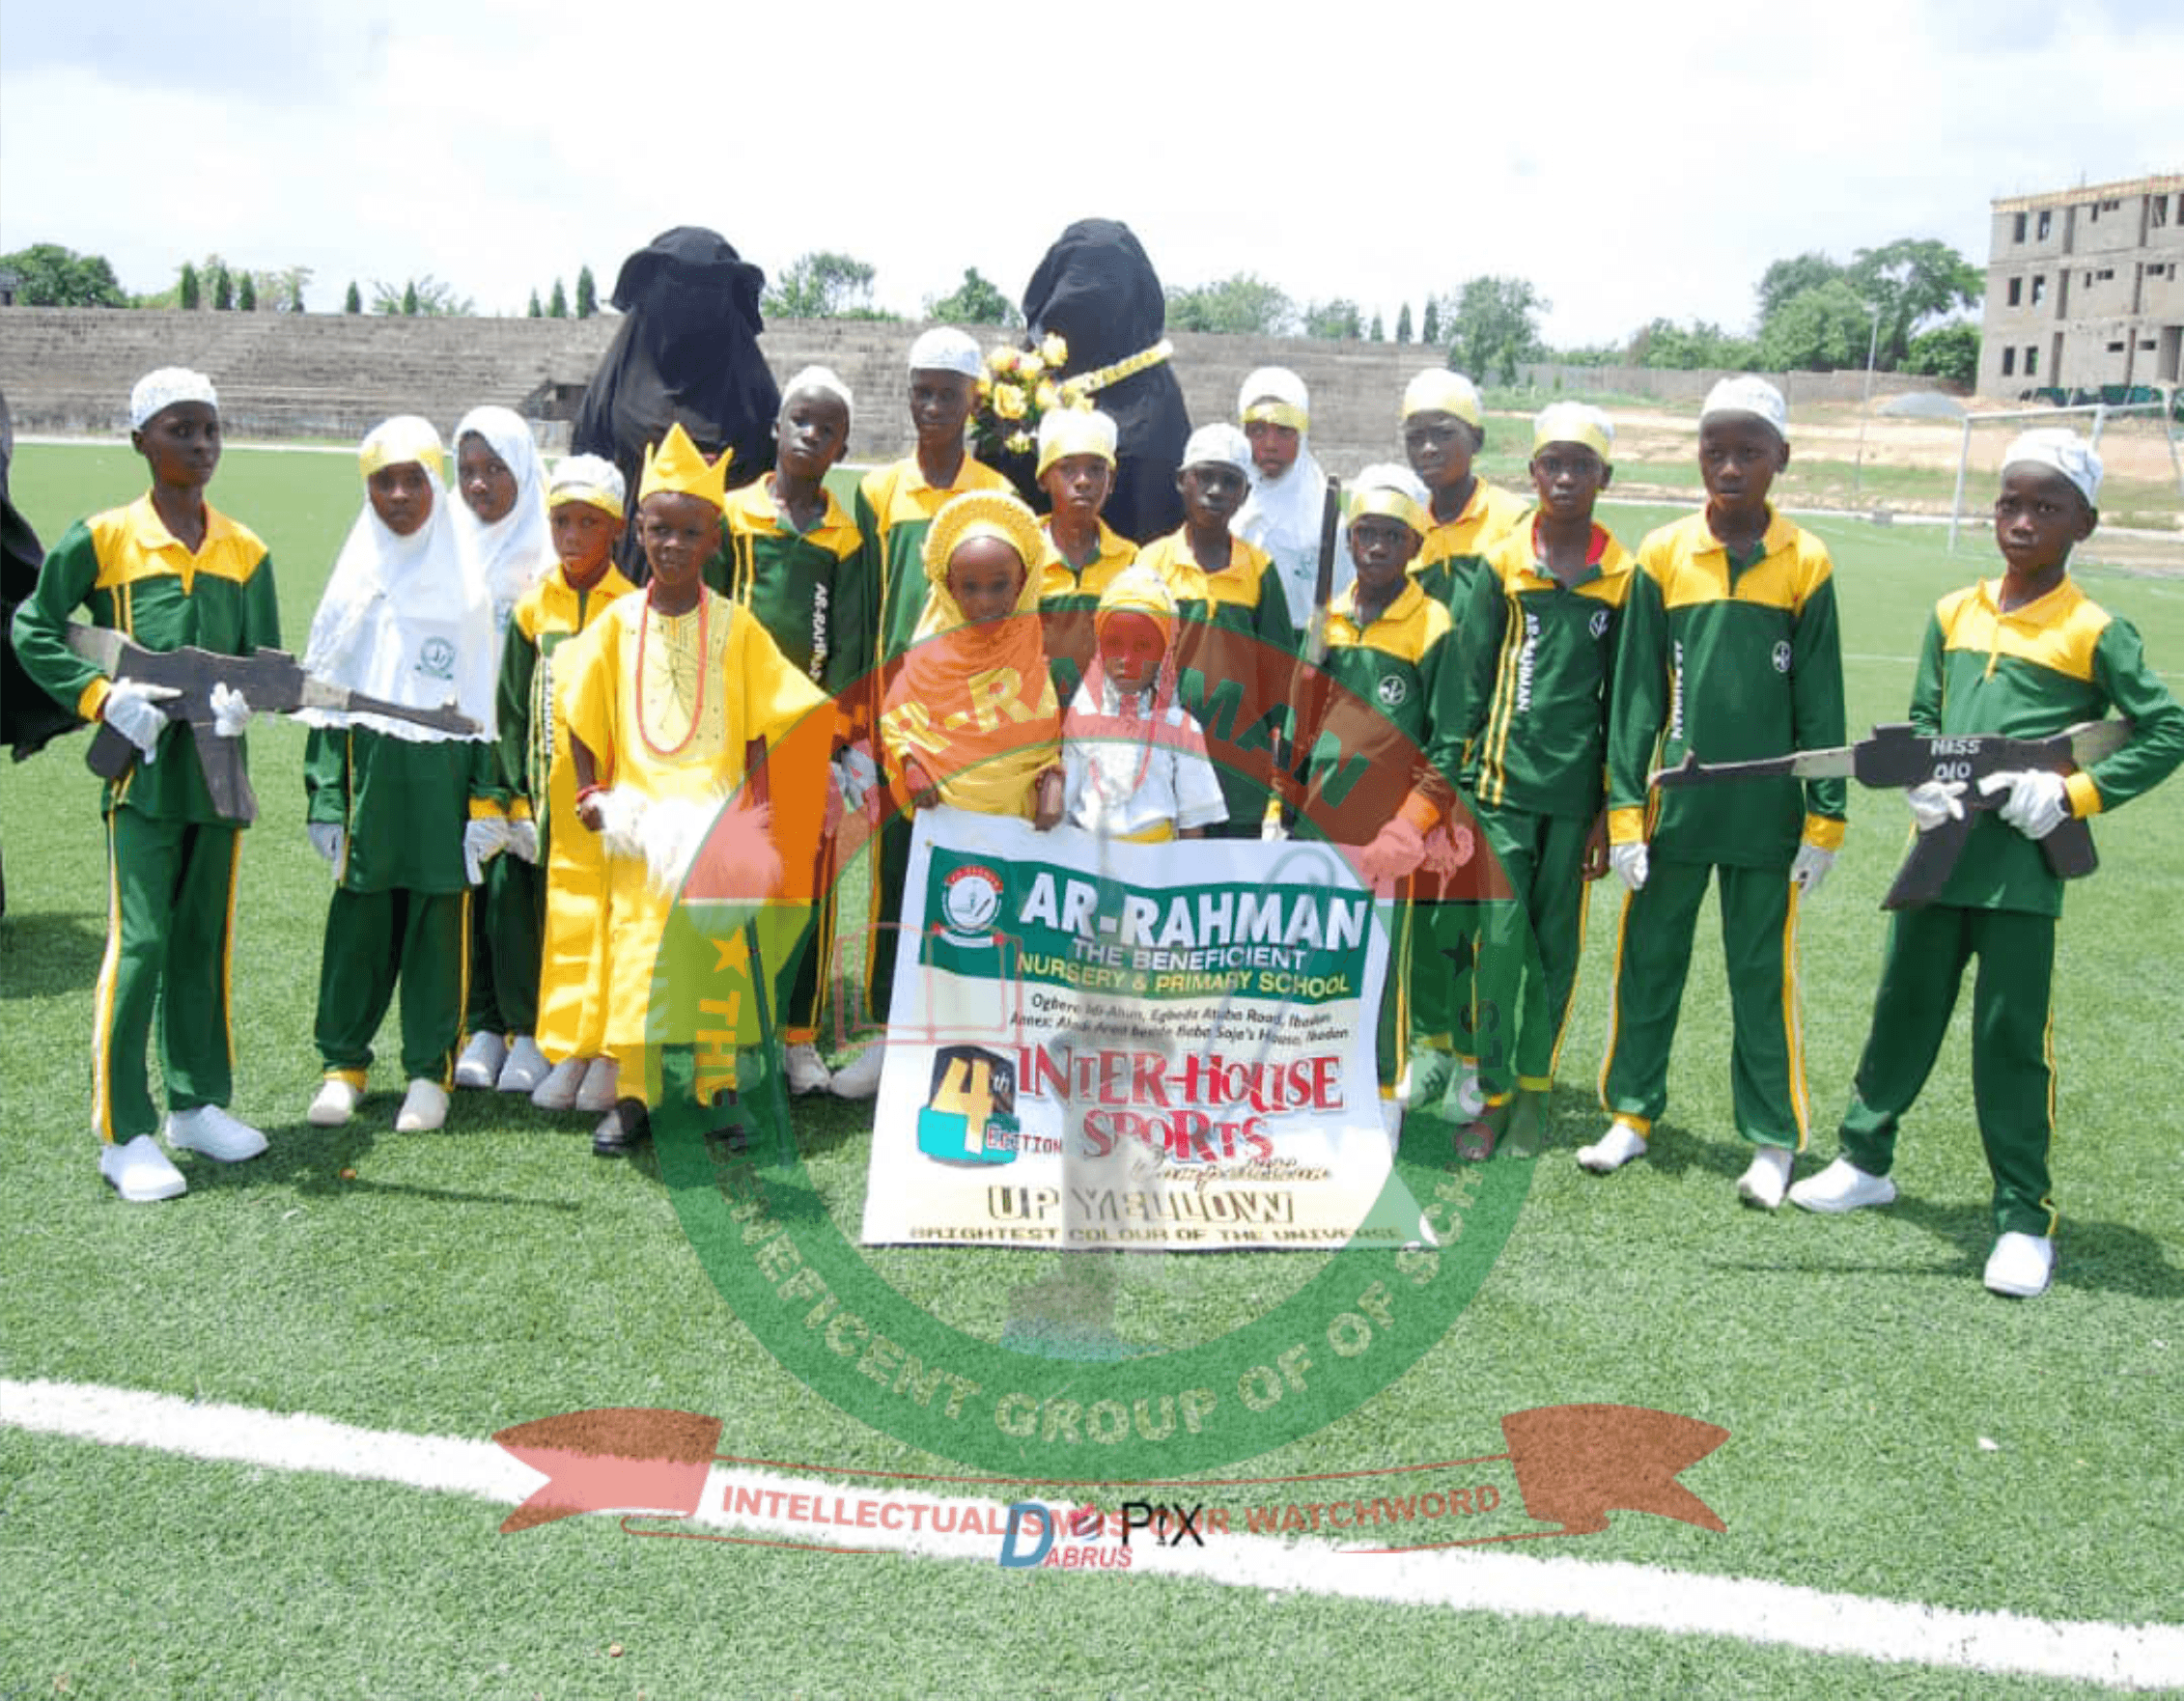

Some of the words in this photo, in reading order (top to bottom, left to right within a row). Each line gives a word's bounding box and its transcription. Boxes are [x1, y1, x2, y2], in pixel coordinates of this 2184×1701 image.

[1019, 872, 1368, 951] AR-RAHMAN
[1073, 937, 1124, 965] THE
[1132, 945, 1307, 971] BENEFICIENT
[1018, 952, 1127, 989] NURSERY
[1132, 973, 1146, 991] &
[1157, 970, 1252, 993] PRIMARY
[1260, 971, 1350, 998] SCHOOL
[1017, 1043, 1344, 1113] INTER-HOUSE
[1082, 1108, 1274, 1163] SPORTS
[987, 1185, 1059, 1221] UP
[1070, 1187, 1295, 1223] YELLOW
[1068, 1227, 1169, 1241] COLOUR
[1174, 1227, 1207, 1241] OF
